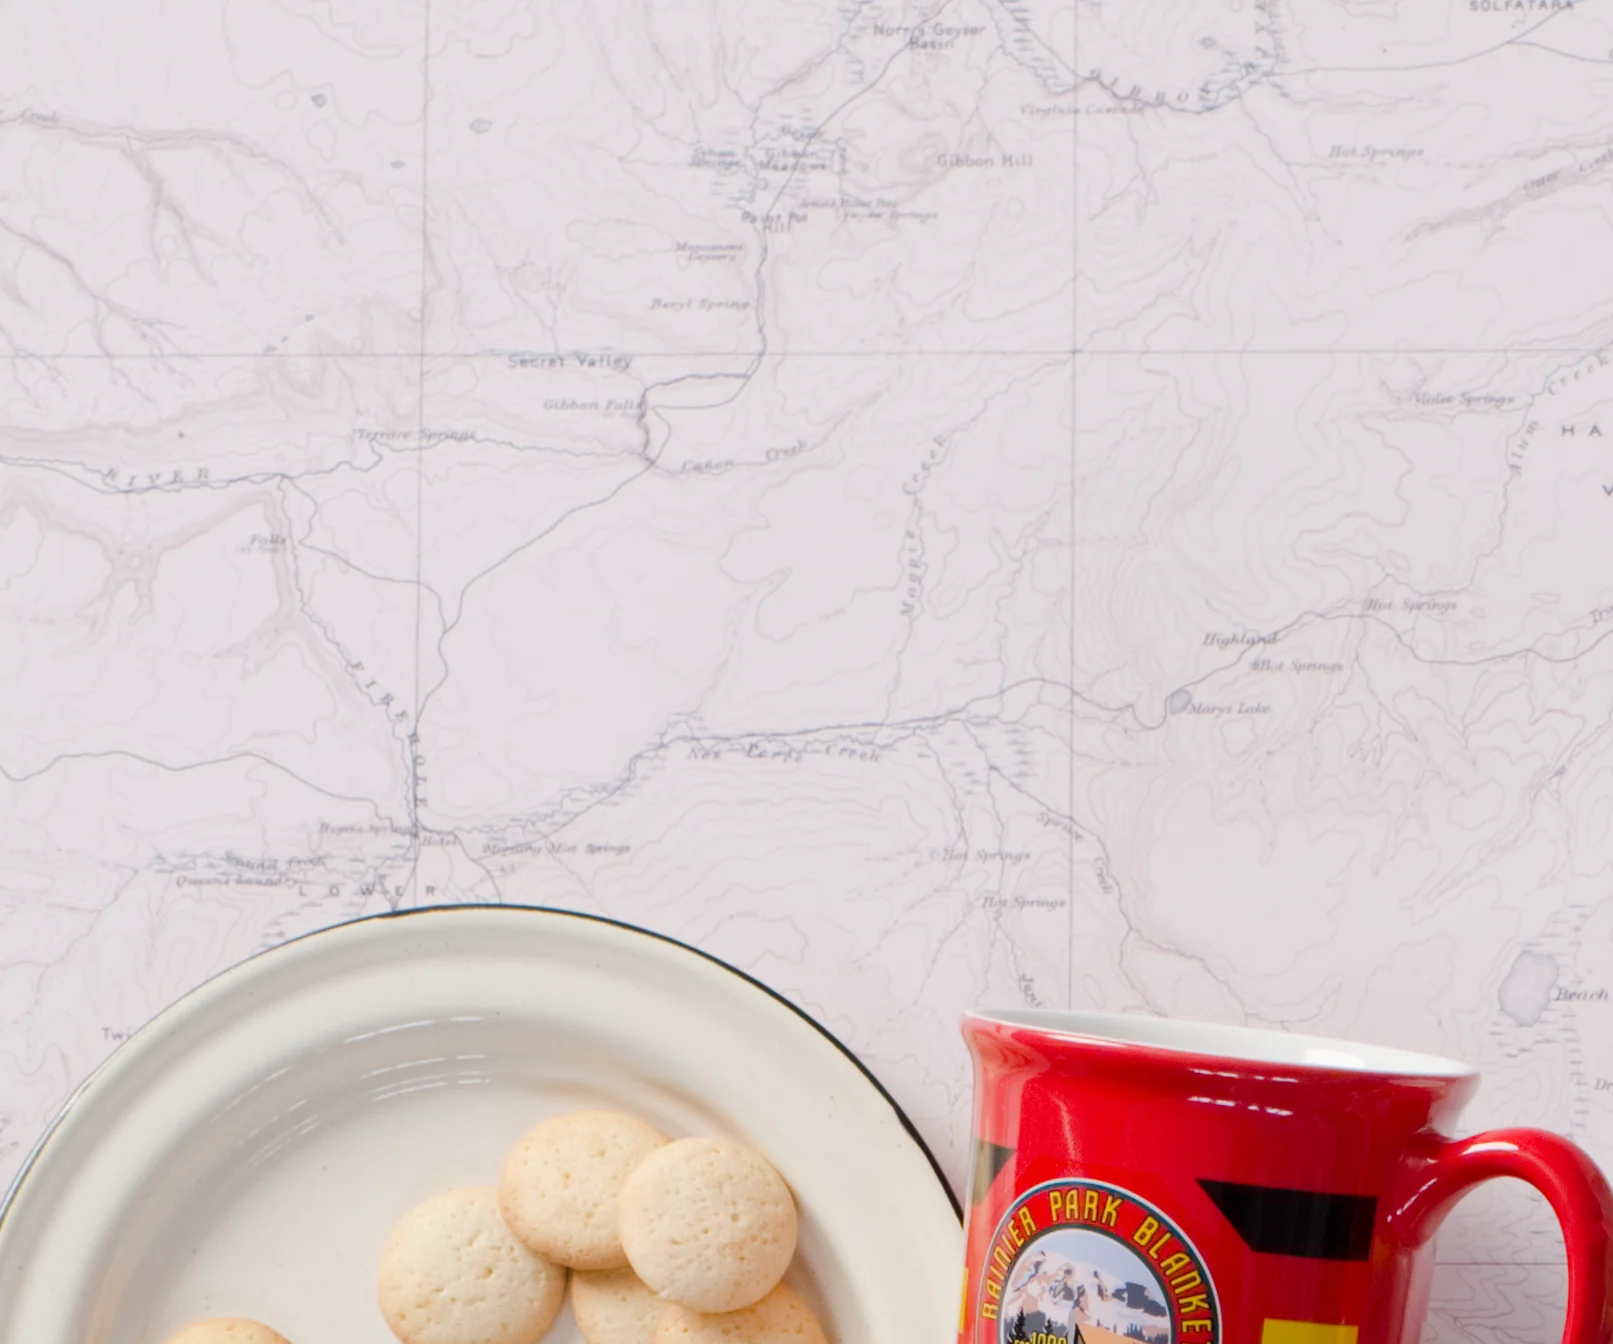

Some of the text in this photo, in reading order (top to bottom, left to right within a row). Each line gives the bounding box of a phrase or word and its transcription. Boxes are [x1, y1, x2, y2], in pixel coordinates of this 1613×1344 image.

[508, 354, 565, 368] Secret
[982, 1206, 1036, 1320] RAINIER
[1050, 1189, 1123, 1226] PARK
